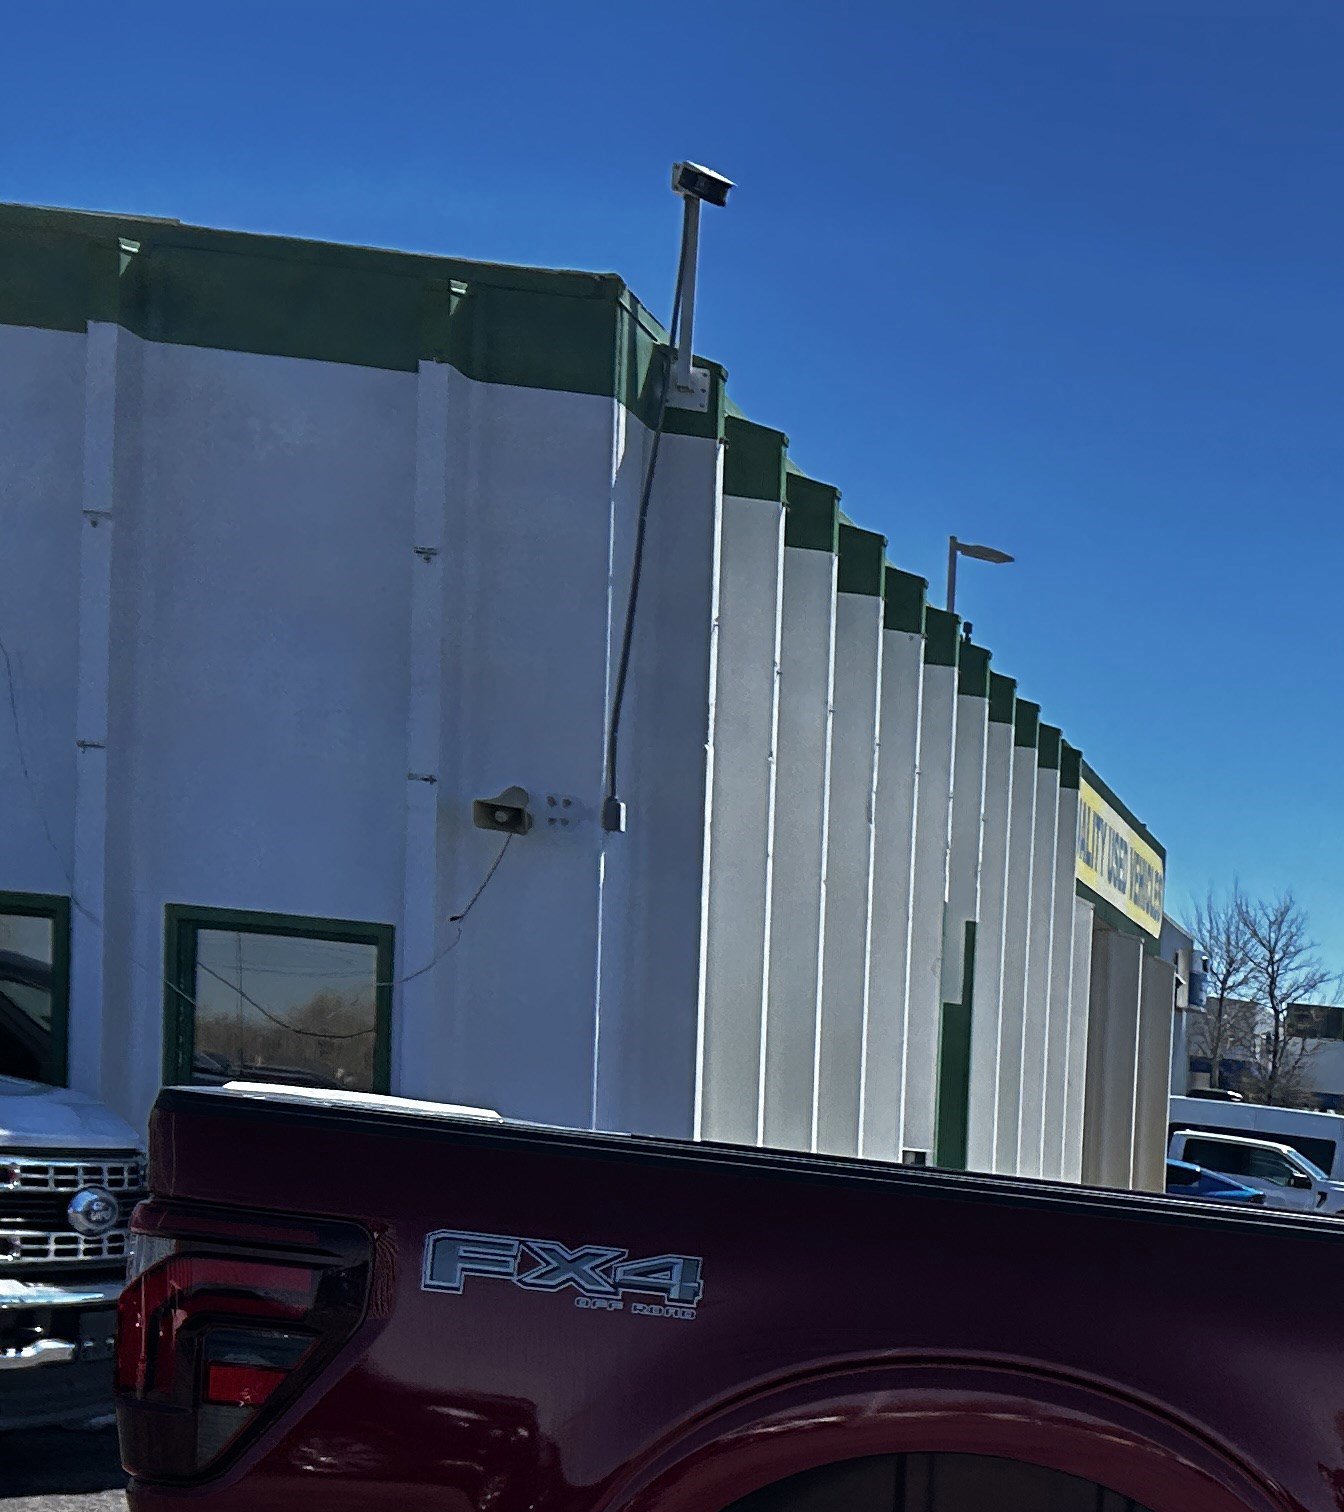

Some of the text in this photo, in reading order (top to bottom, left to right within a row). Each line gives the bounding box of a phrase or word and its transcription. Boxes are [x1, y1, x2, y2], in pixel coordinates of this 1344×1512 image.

[1107, 824, 1128, 895] USED
[1129, 846, 1164, 924] VEHICLES
[421, 1229, 703, 1307] FX4
[575, 1296, 697, 1321] OFF ROAD
